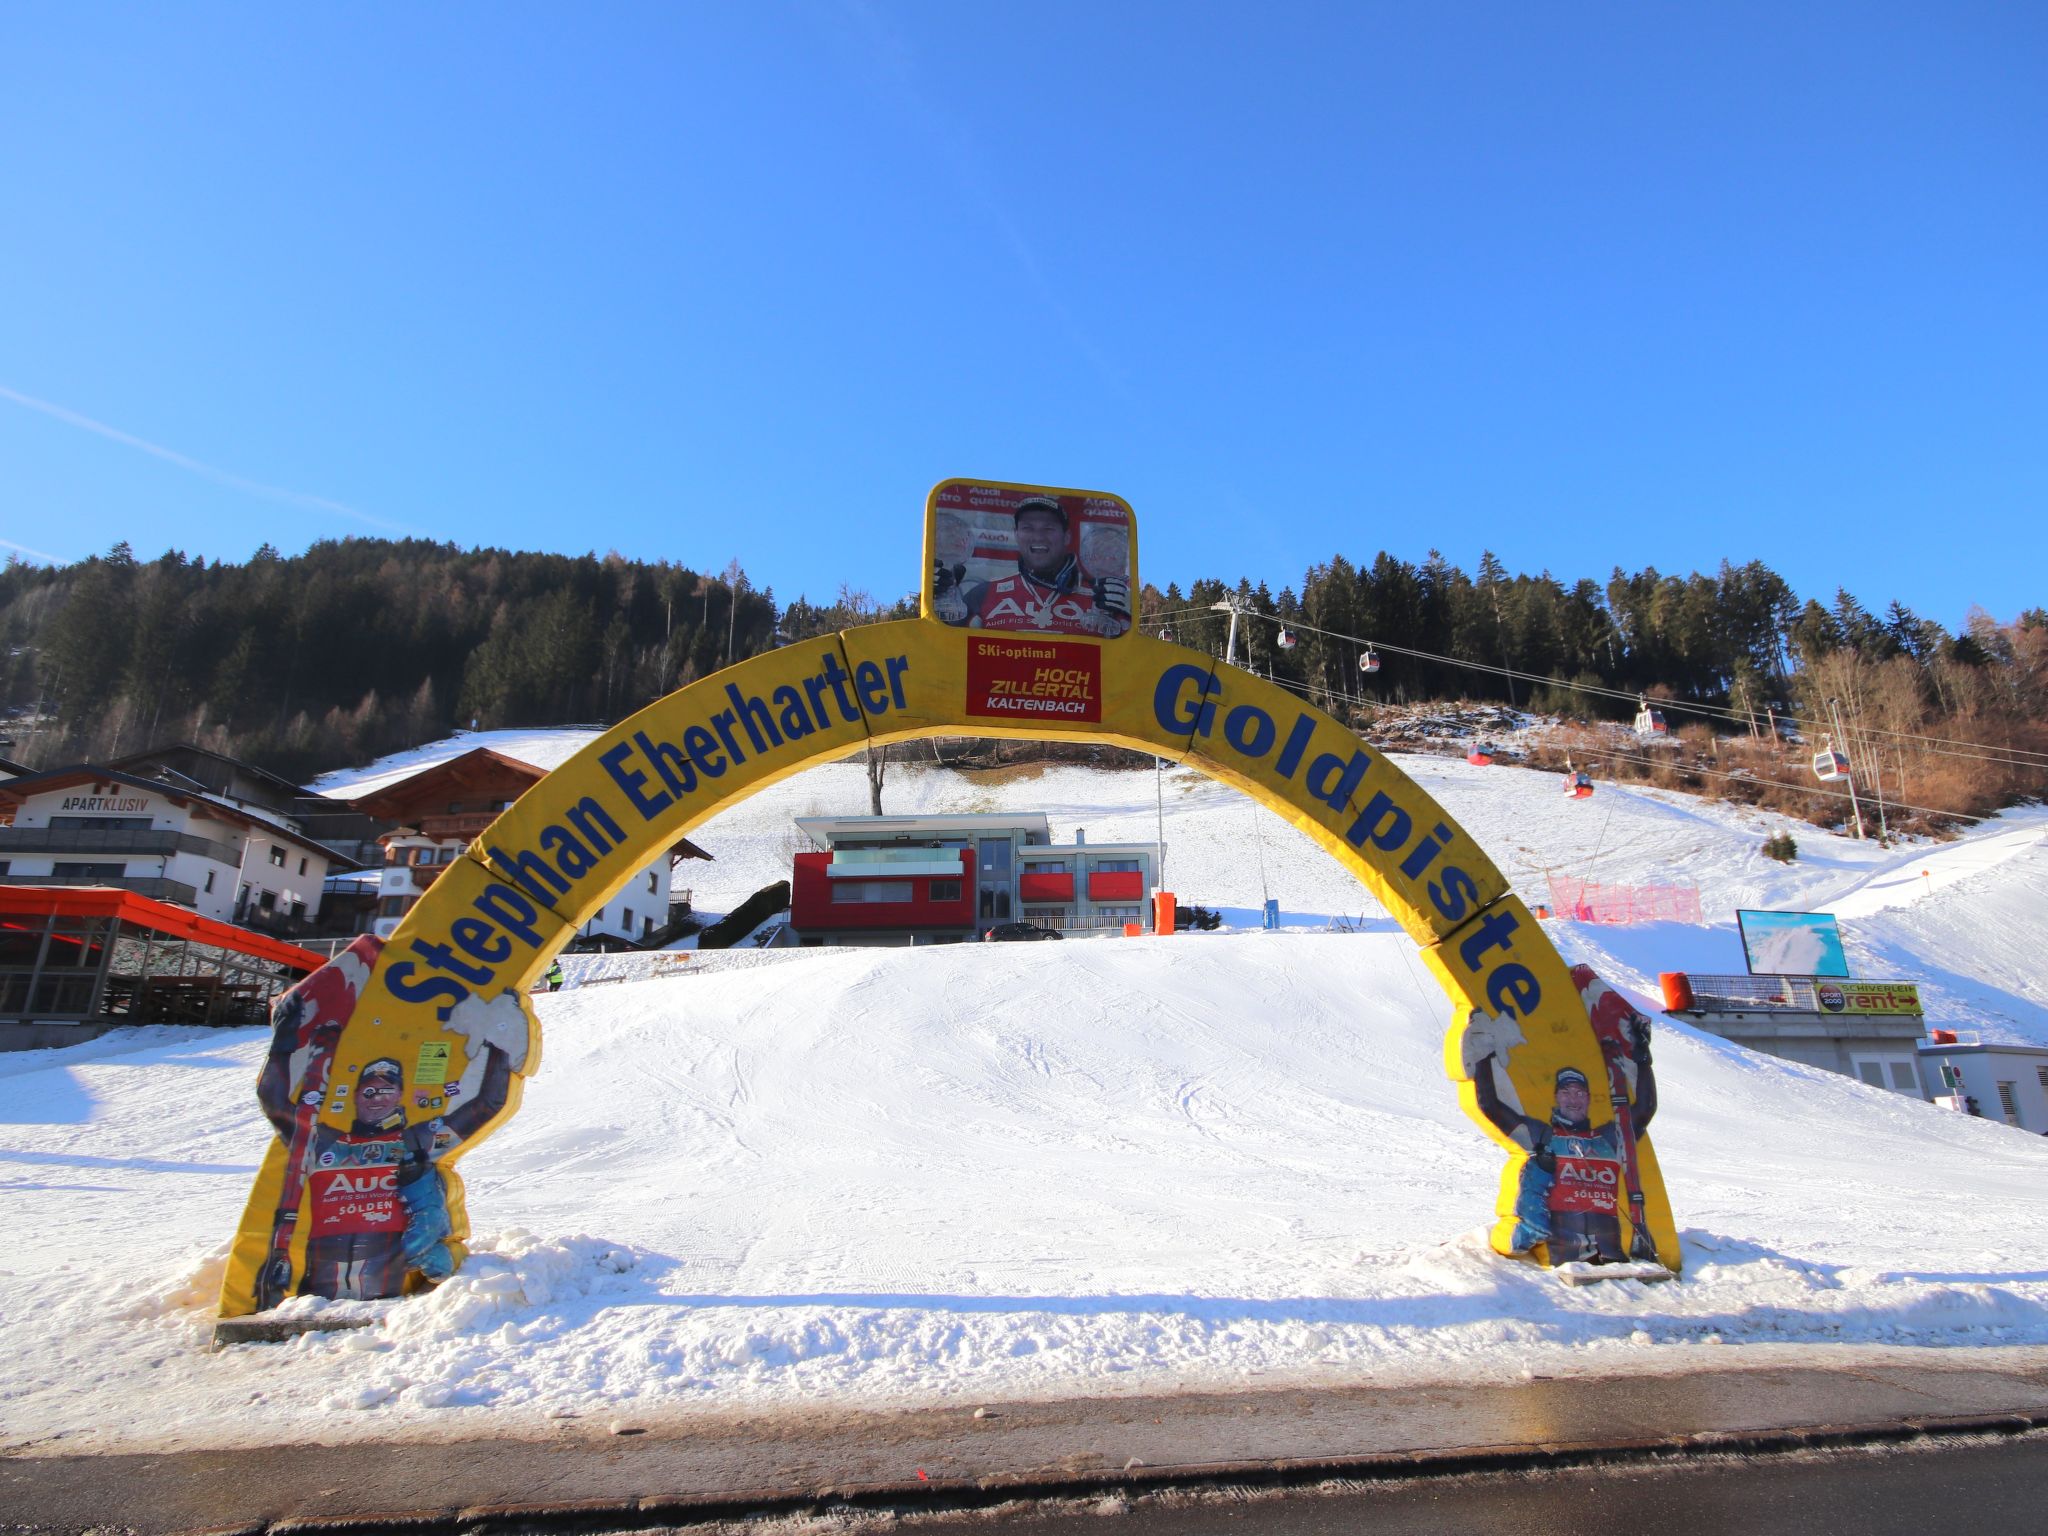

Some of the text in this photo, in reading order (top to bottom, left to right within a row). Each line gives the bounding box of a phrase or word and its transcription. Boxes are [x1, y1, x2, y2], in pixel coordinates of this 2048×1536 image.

[1034, 668, 1091, 685] HOCH
[989, 680, 1094, 700] ZILLERTAL
[986, 697, 1086, 714] KALTENBACH
[384, 652, 1542, 1021] Stephan Eberharter Goldpiste
[1845, 992, 1900, 1009] rent
[1559, 1163, 1617, 1185] Aud
